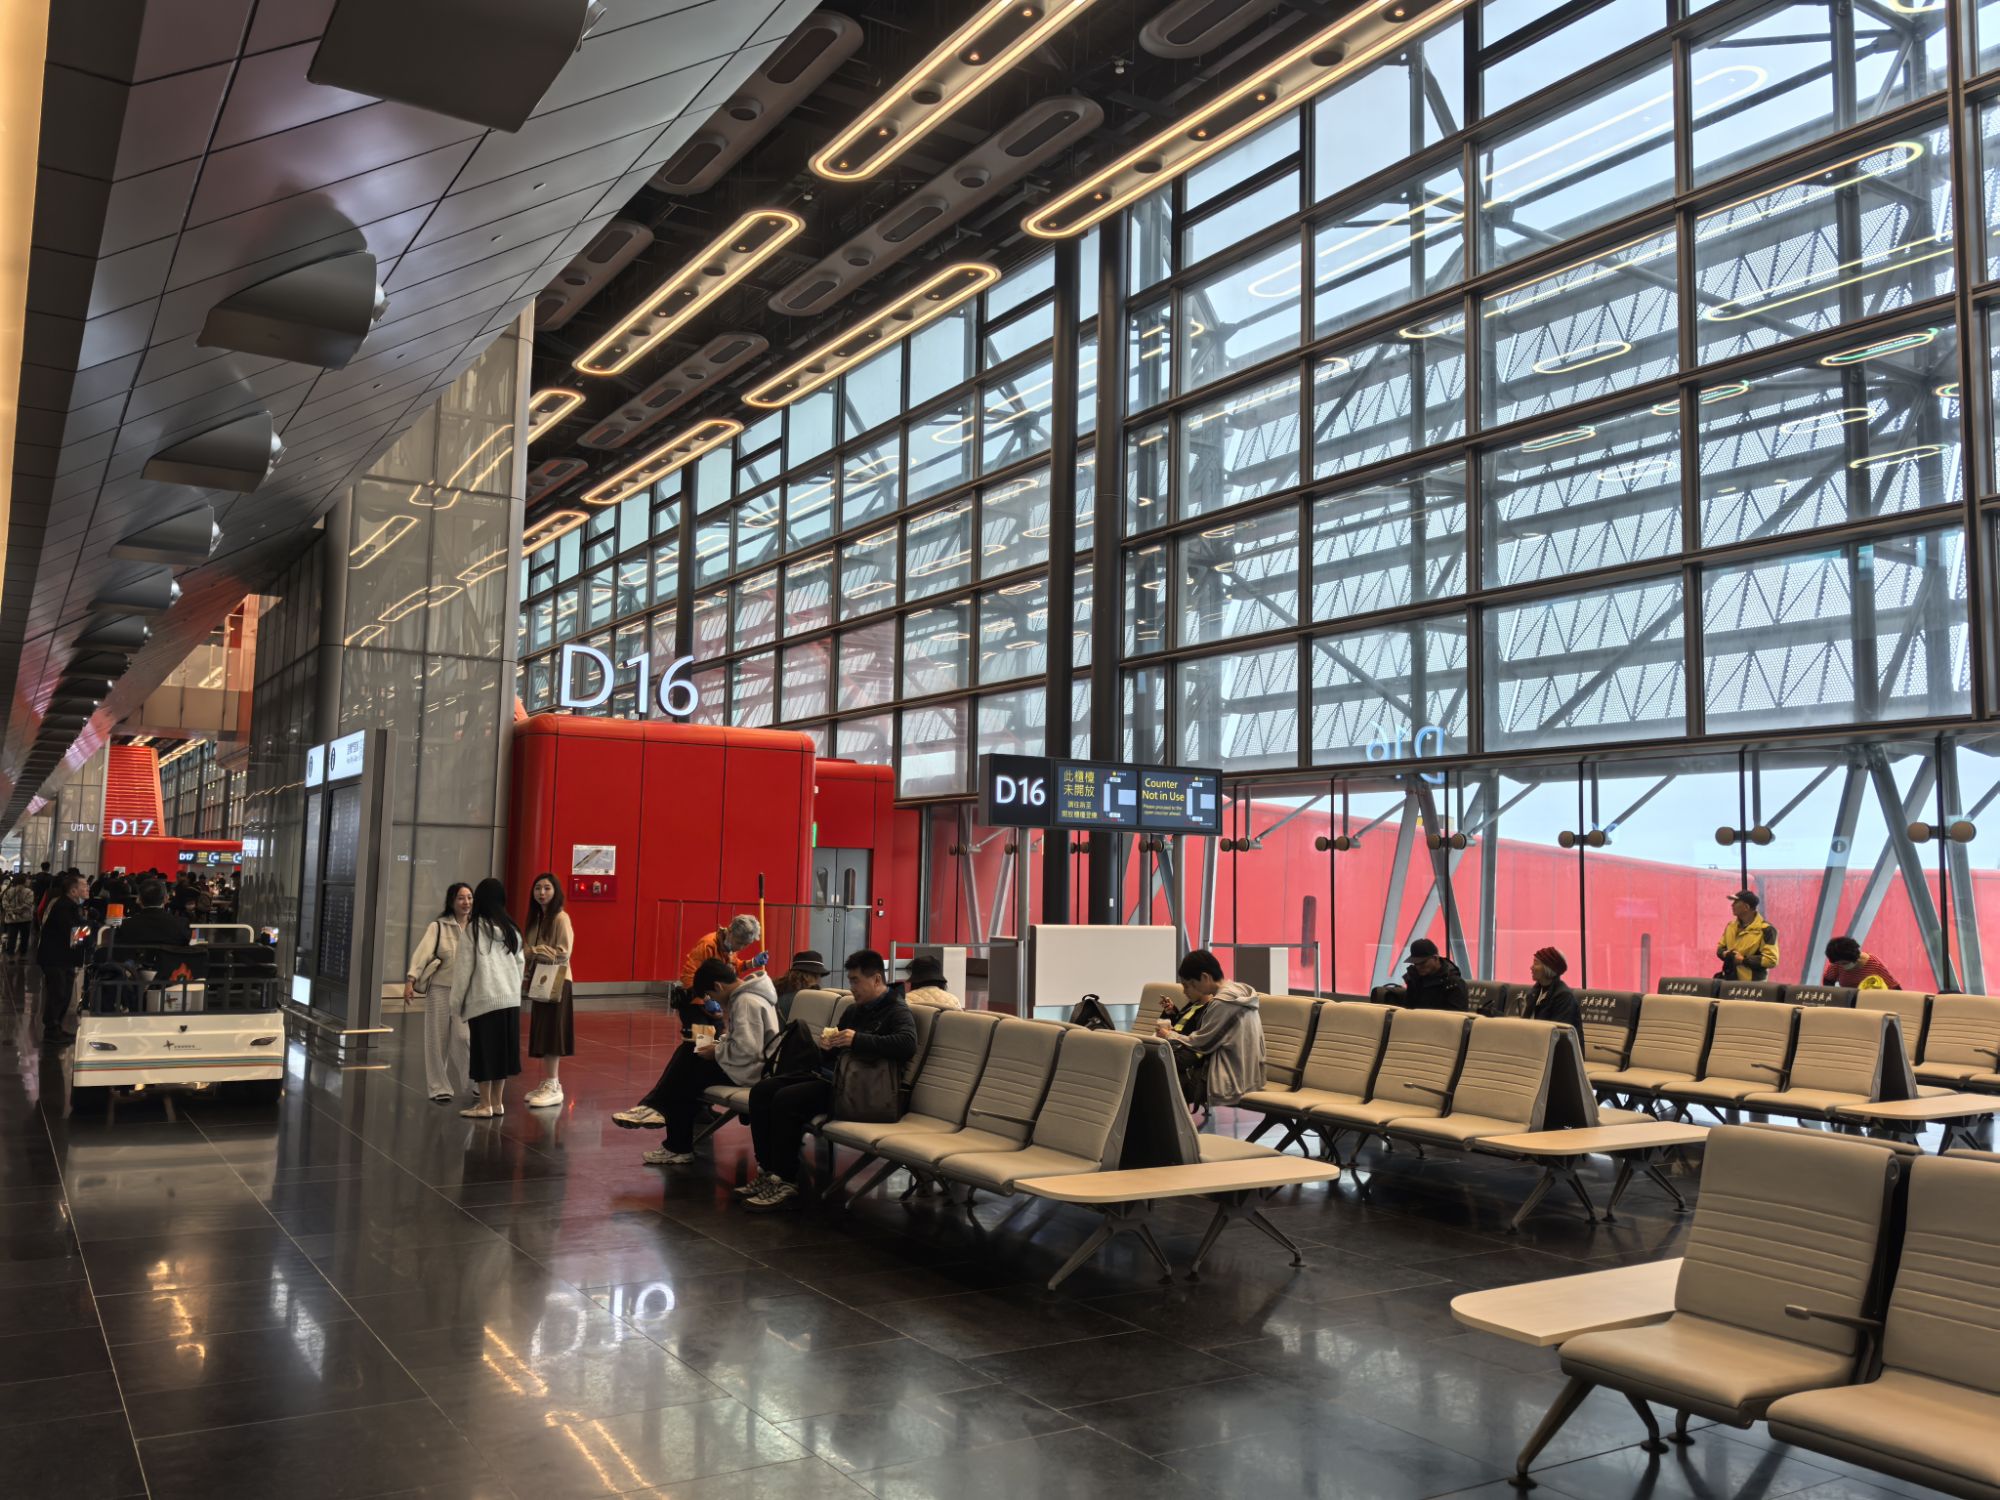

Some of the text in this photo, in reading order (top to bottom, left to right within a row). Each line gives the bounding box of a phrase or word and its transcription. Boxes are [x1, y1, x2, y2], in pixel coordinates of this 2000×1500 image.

[558, 643, 700, 718] D16
[995, 774, 1046, 806] D16
[1063, 783, 1095, 798] 未開放
[1144, 777, 1178, 789] Counter
[1142, 789, 1185, 802] Not in Use
[111, 819, 154, 836] D17
[179, 853, 194, 861] D17
